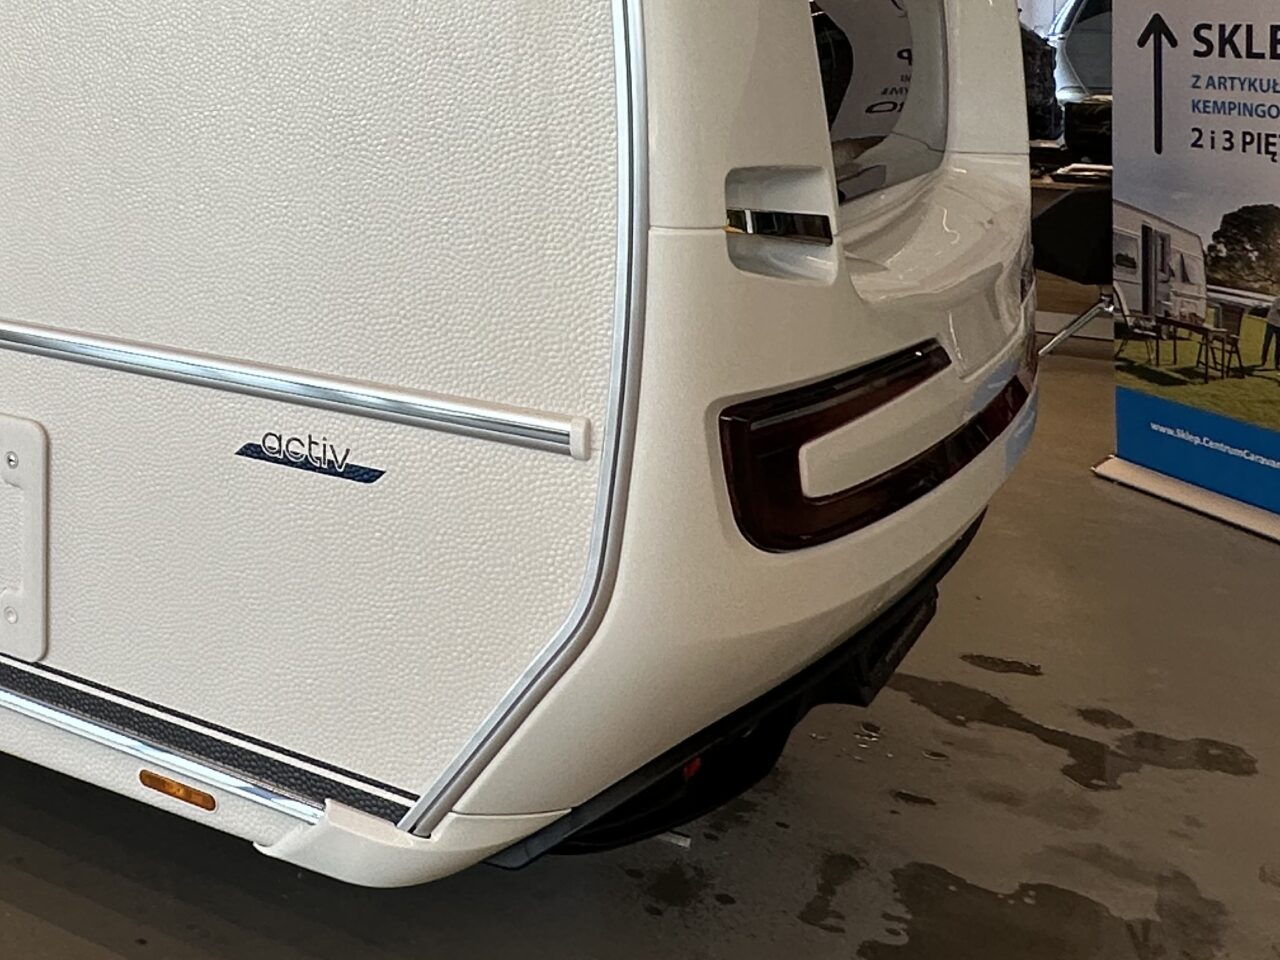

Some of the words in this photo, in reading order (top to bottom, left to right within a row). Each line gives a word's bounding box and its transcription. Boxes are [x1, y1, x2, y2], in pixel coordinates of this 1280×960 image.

[1191, 75, 1201, 89] Z
[1205, 75, 1280, 94] ARTYKUŁ
[1191, 98, 1280, 119] KEMPINGO
[1190, 127, 1204, 148] 2
[1210, 130, 1215, 150] i
[1222, 129, 1234, 151] 3
[1241, 131, 1280, 163] PIĘ
[261, 431, 351, 471] activ
